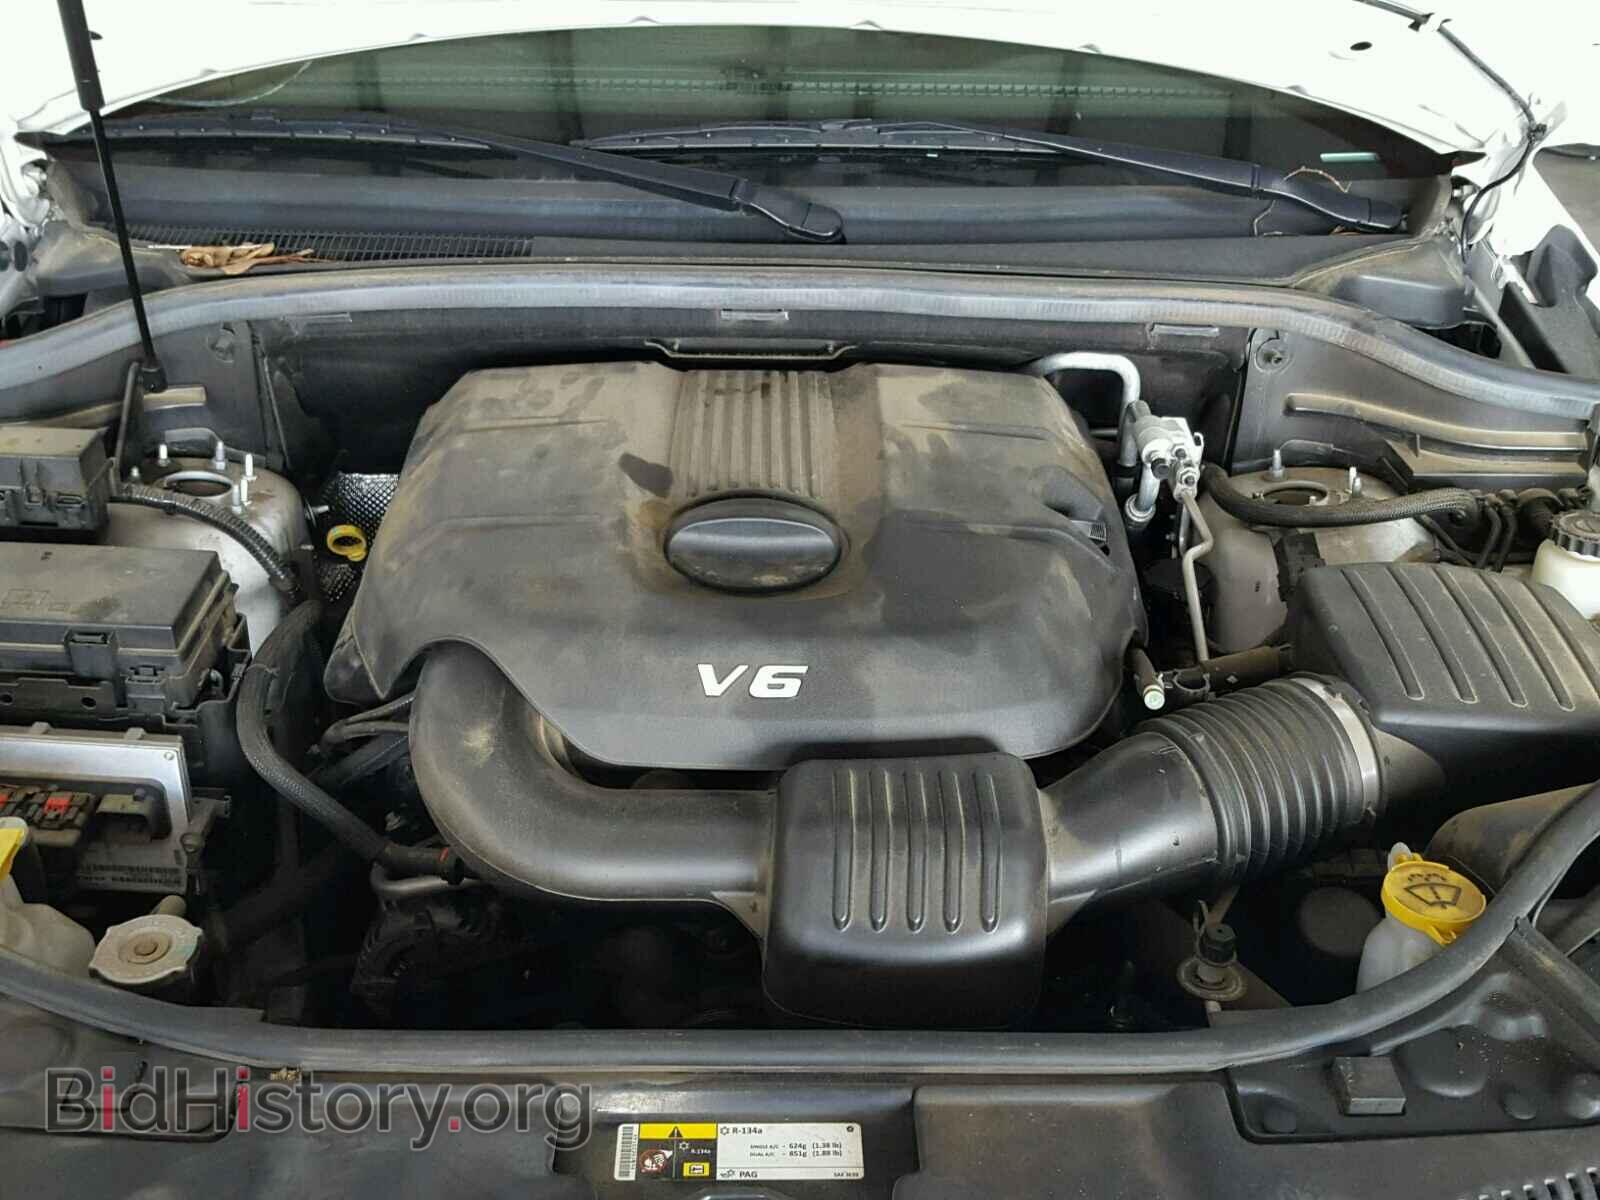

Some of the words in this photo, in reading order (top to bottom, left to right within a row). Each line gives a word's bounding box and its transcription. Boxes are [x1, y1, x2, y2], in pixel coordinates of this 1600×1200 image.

[697, 663, 809, 698] V6
[732, 1126, 763, 1135] R-134a
[789, 1142, 807, 1150] 624g
[739, 1170, 758, 1178] PAG
